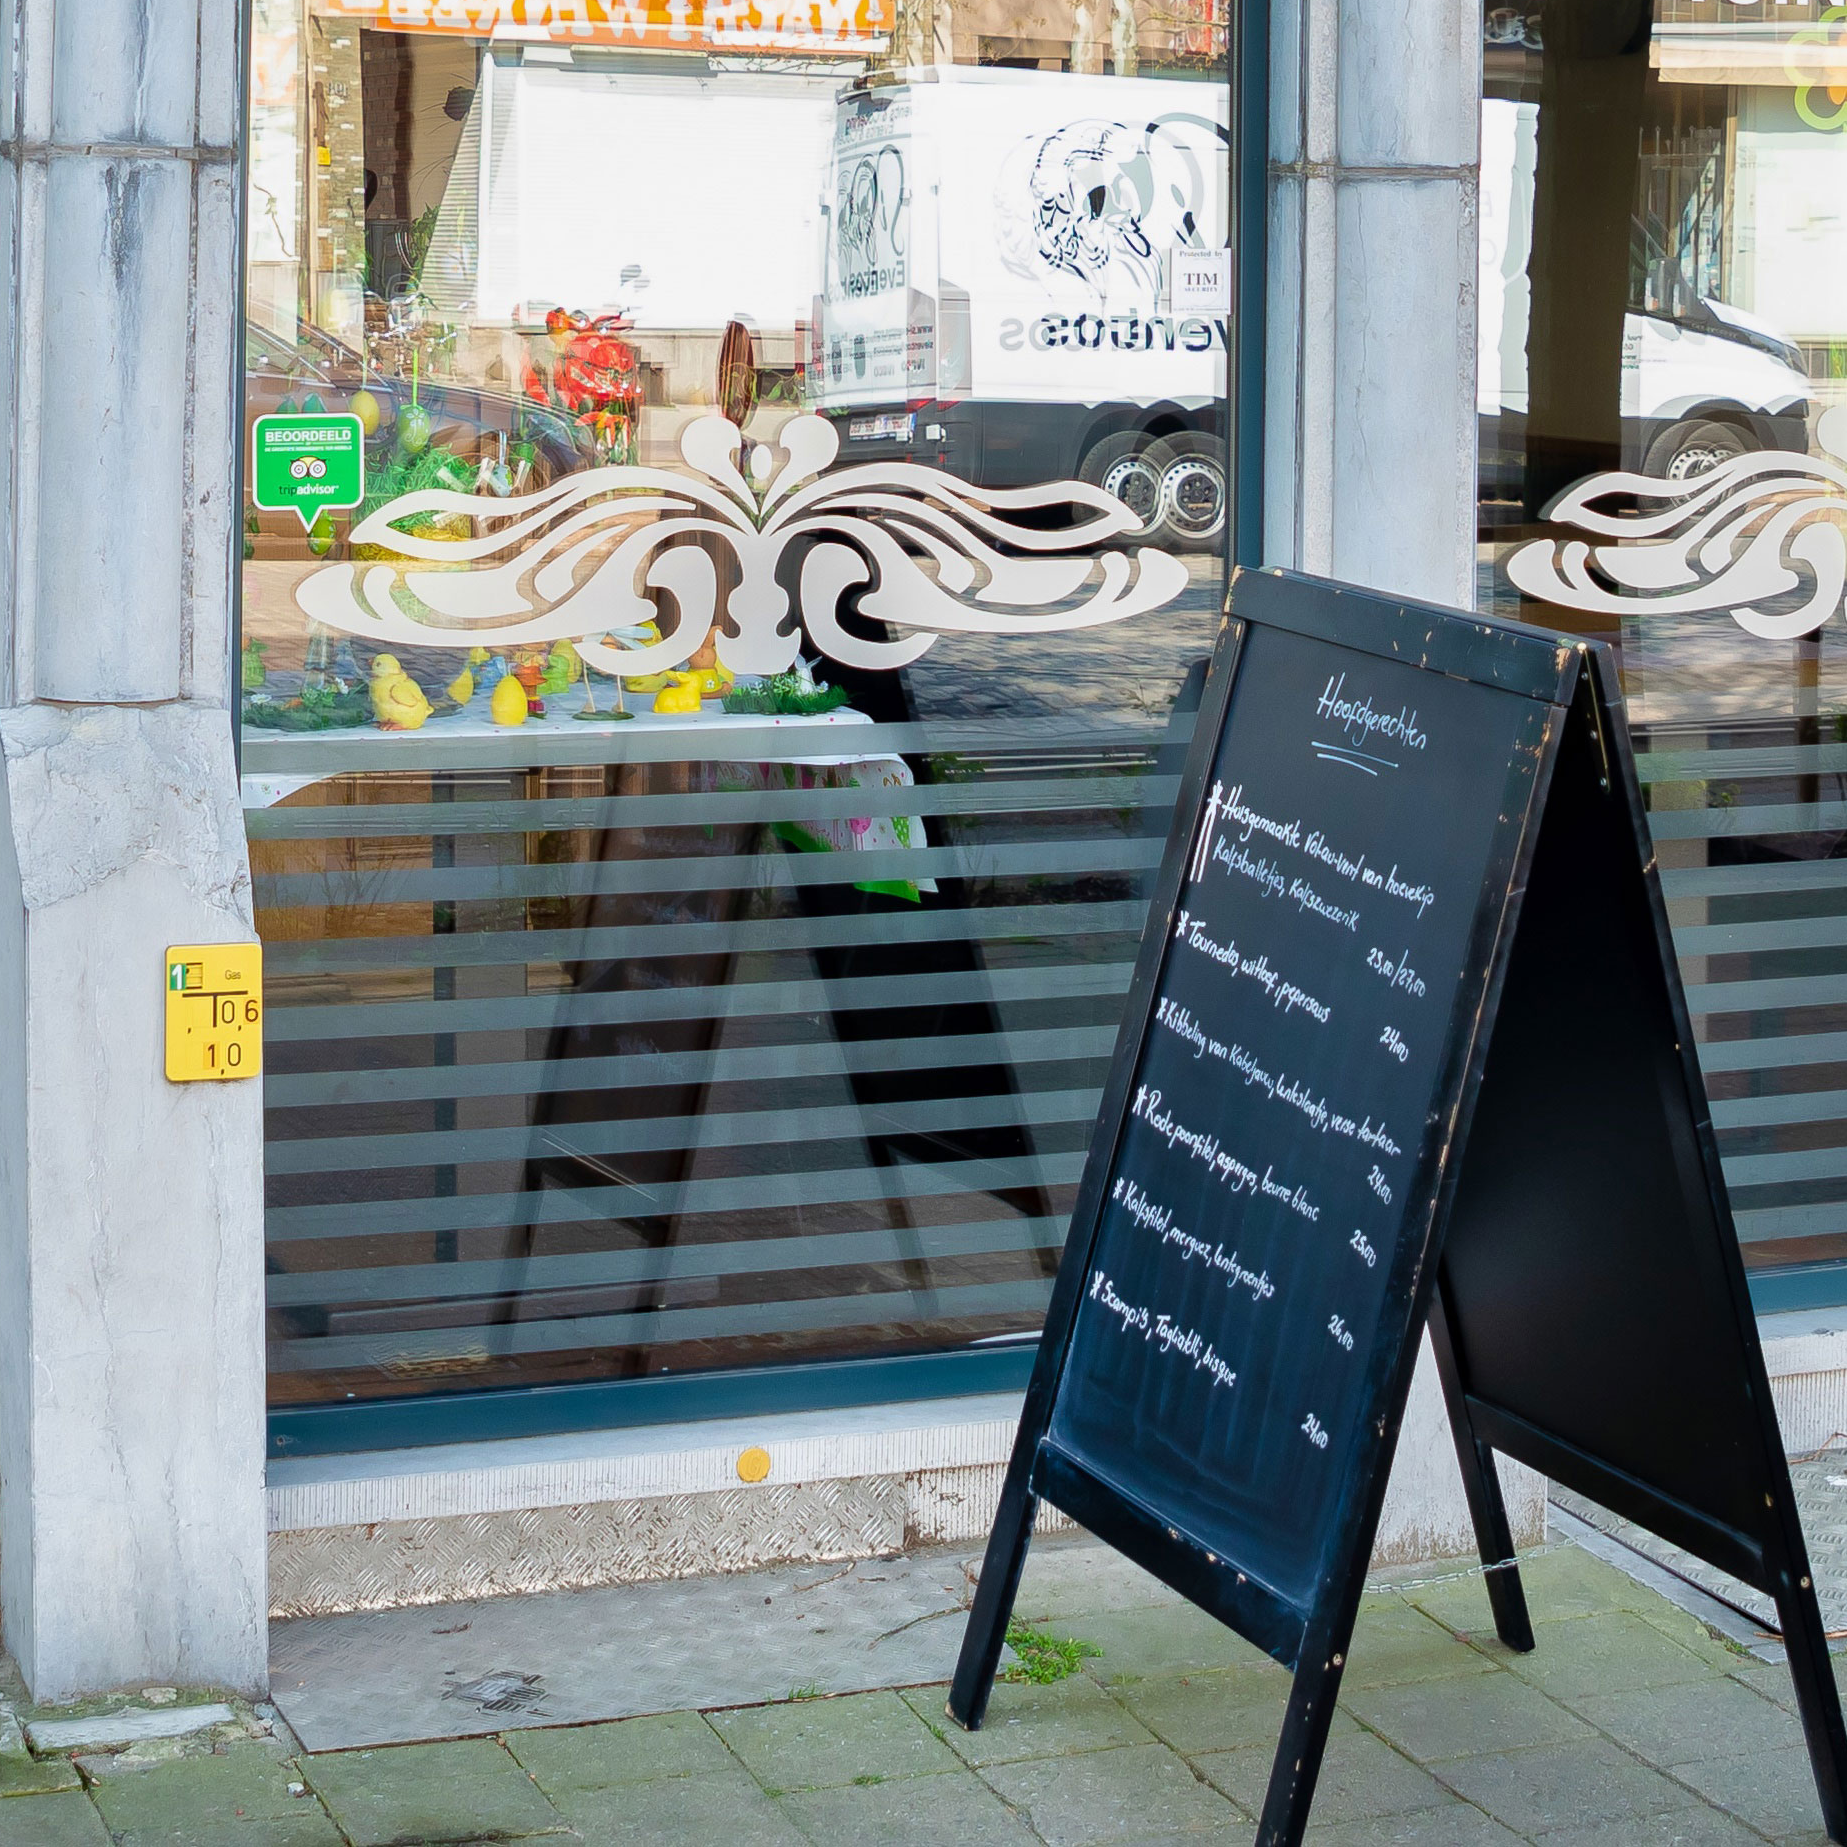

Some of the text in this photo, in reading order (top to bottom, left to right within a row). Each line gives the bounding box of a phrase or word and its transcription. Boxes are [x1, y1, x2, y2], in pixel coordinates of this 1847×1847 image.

[1184, 273, 1218, 286] TIM
[265, 429, 351, 442] BEOORDEELD
[279, 483, 337, 496] tripadvisor
[1316, 672, 1426, 750] Hoofdgerechten
[1362, 867, 1384, 890] van
[225, 970, 241, 980] Gas
[1164, 1001, 1206, 1059] Kibbeling
[1208, 1038, 1228, 1060] van
[1331, 1113, 1355, 1136] verse
[1144, 1090, 1173, 1137] Rode
[1291, 1185, 1320, 1222] blanc
[1202, 1344, 1237, 1387] bisque
